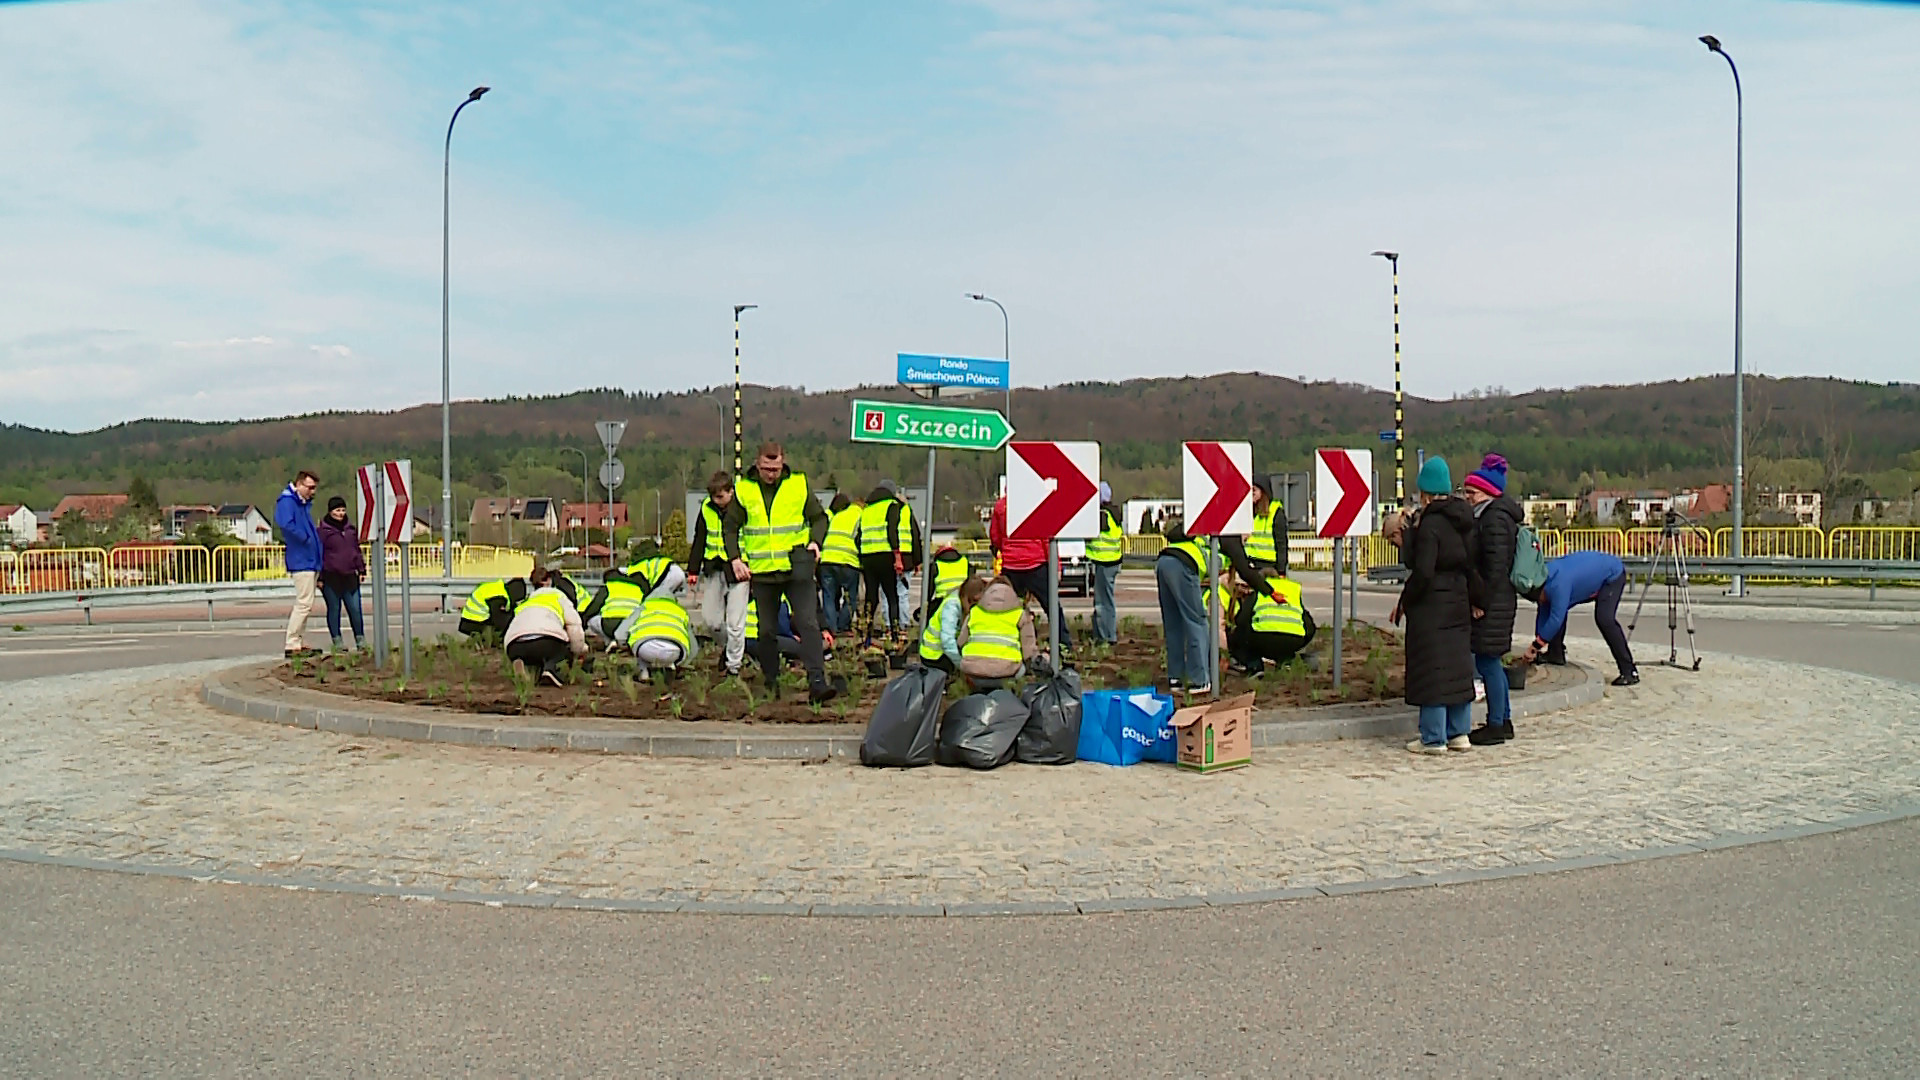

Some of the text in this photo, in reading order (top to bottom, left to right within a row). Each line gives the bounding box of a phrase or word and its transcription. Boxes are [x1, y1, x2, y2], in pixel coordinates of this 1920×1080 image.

[939, 359, 968, 370] Rondo
[966, 373, 1000, 386] Północ
[869, 413, 991, 440] 6 Szczecin
